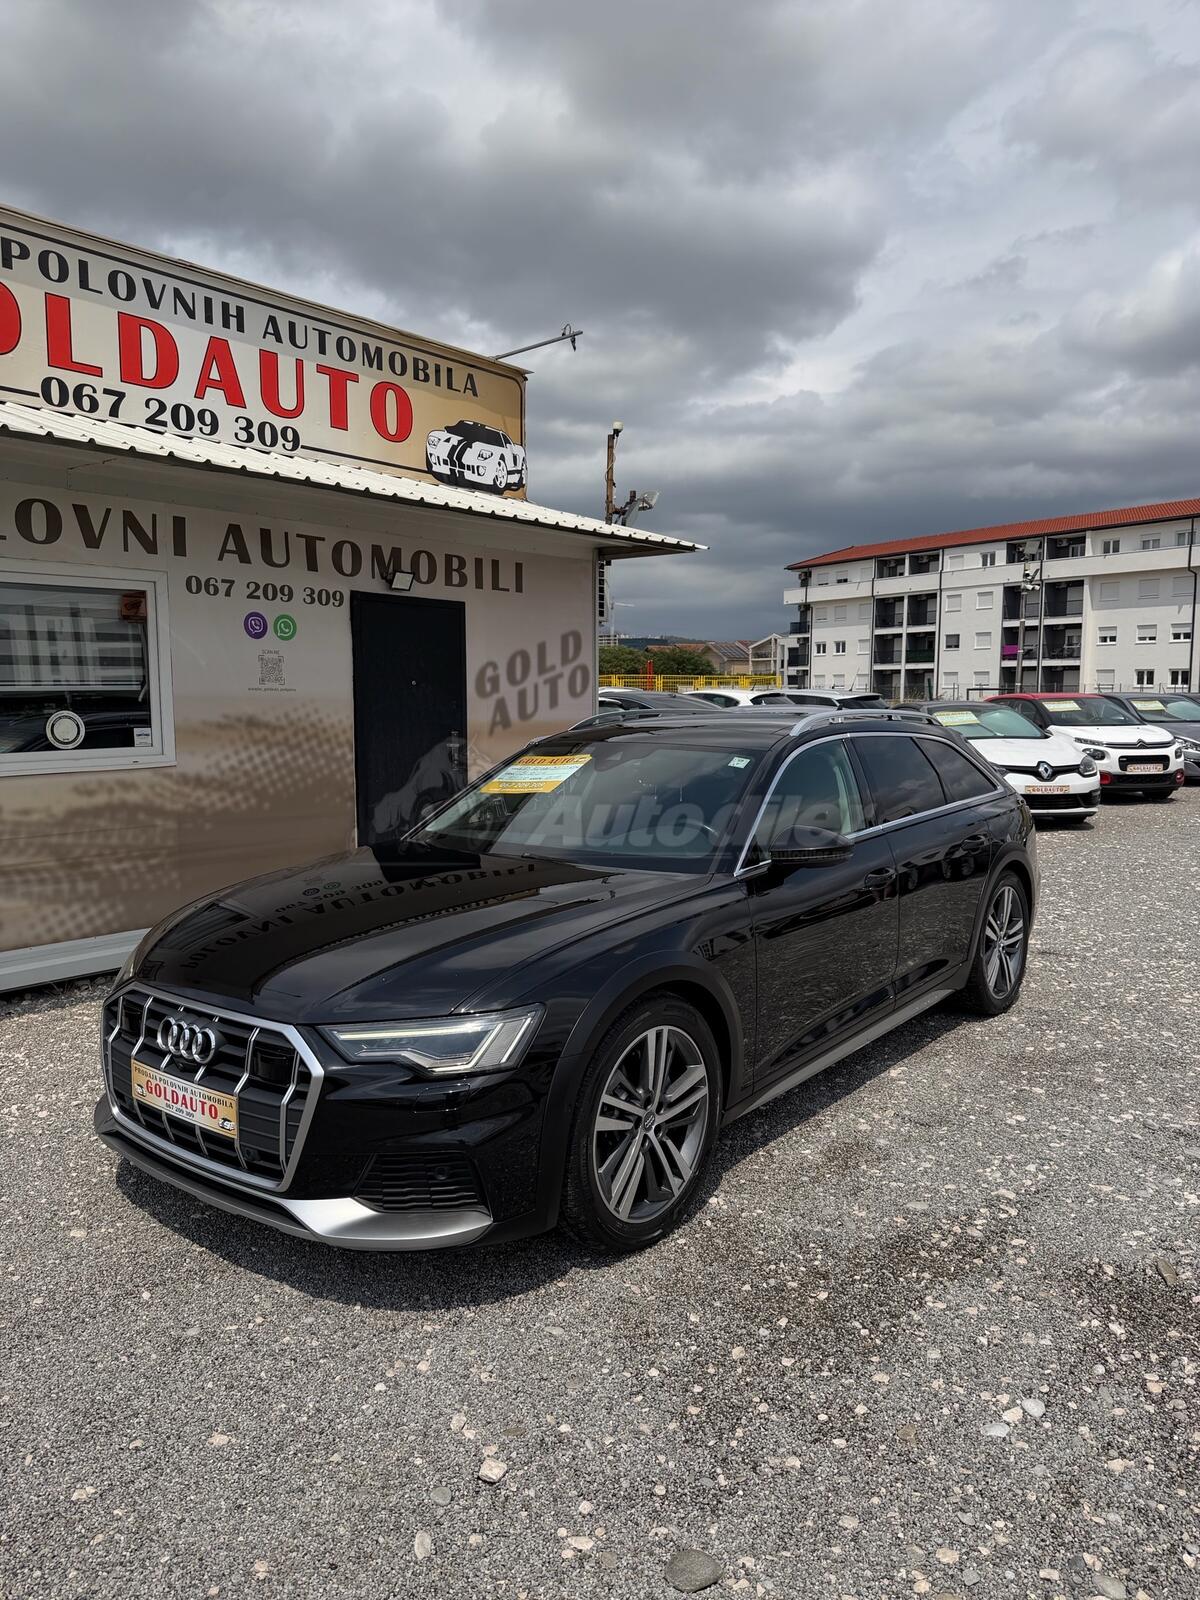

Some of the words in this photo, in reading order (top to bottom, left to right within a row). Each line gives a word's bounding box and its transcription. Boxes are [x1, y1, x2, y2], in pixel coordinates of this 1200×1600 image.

[1, 236, 245, 334] POLOVNIH
[262, 314, 479, 398] AUTOMOBILA
[40, 376, 126, 419] 067
[144, 398, 219, 437] 209
[234, 416, 300, 451] 309
[0, 498, 187, 558] OVNI
[217, 523, 523, 593] AUTOMOBILI
[185, 575, 236, 597] 067
[246, 581, 294, 603] 209
[303, 587, 344, 608] 309
[475, 630, 582, 699] GOLD
[489, 663, 590, 737] AUTO
[145, 1079, 218, 1120] GOLDAUTO
[189, 1089, 234, 1110] AUTOMOBILA
